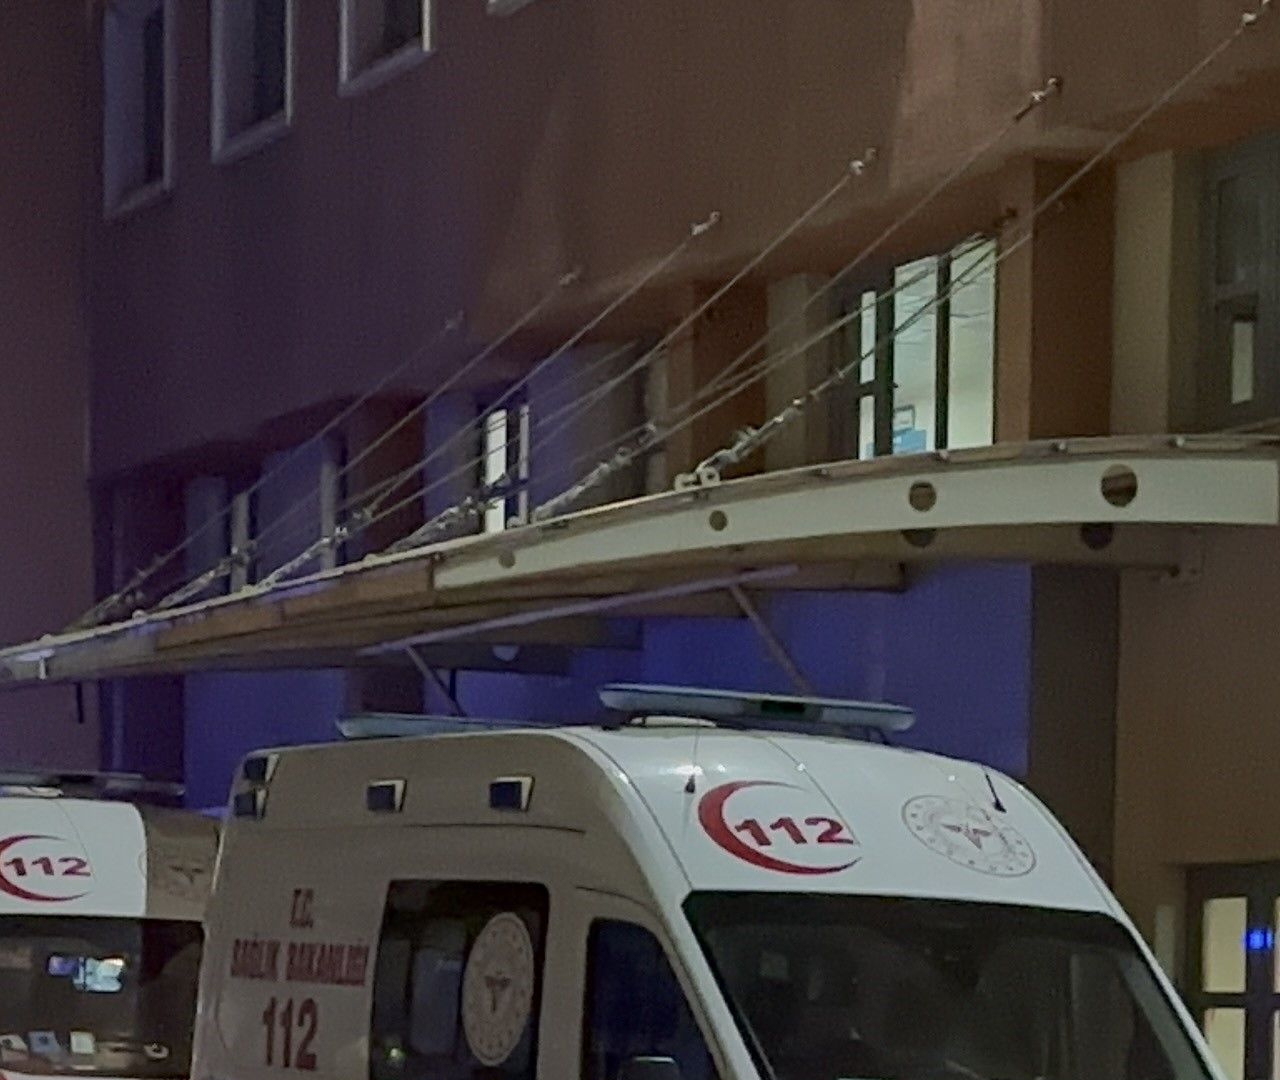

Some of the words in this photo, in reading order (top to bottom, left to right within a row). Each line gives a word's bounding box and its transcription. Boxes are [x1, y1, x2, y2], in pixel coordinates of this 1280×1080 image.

[734, 816, 854, 846] 112
[4, 856, 91, 876] 112
[263, 996, 318, 1071] 112
